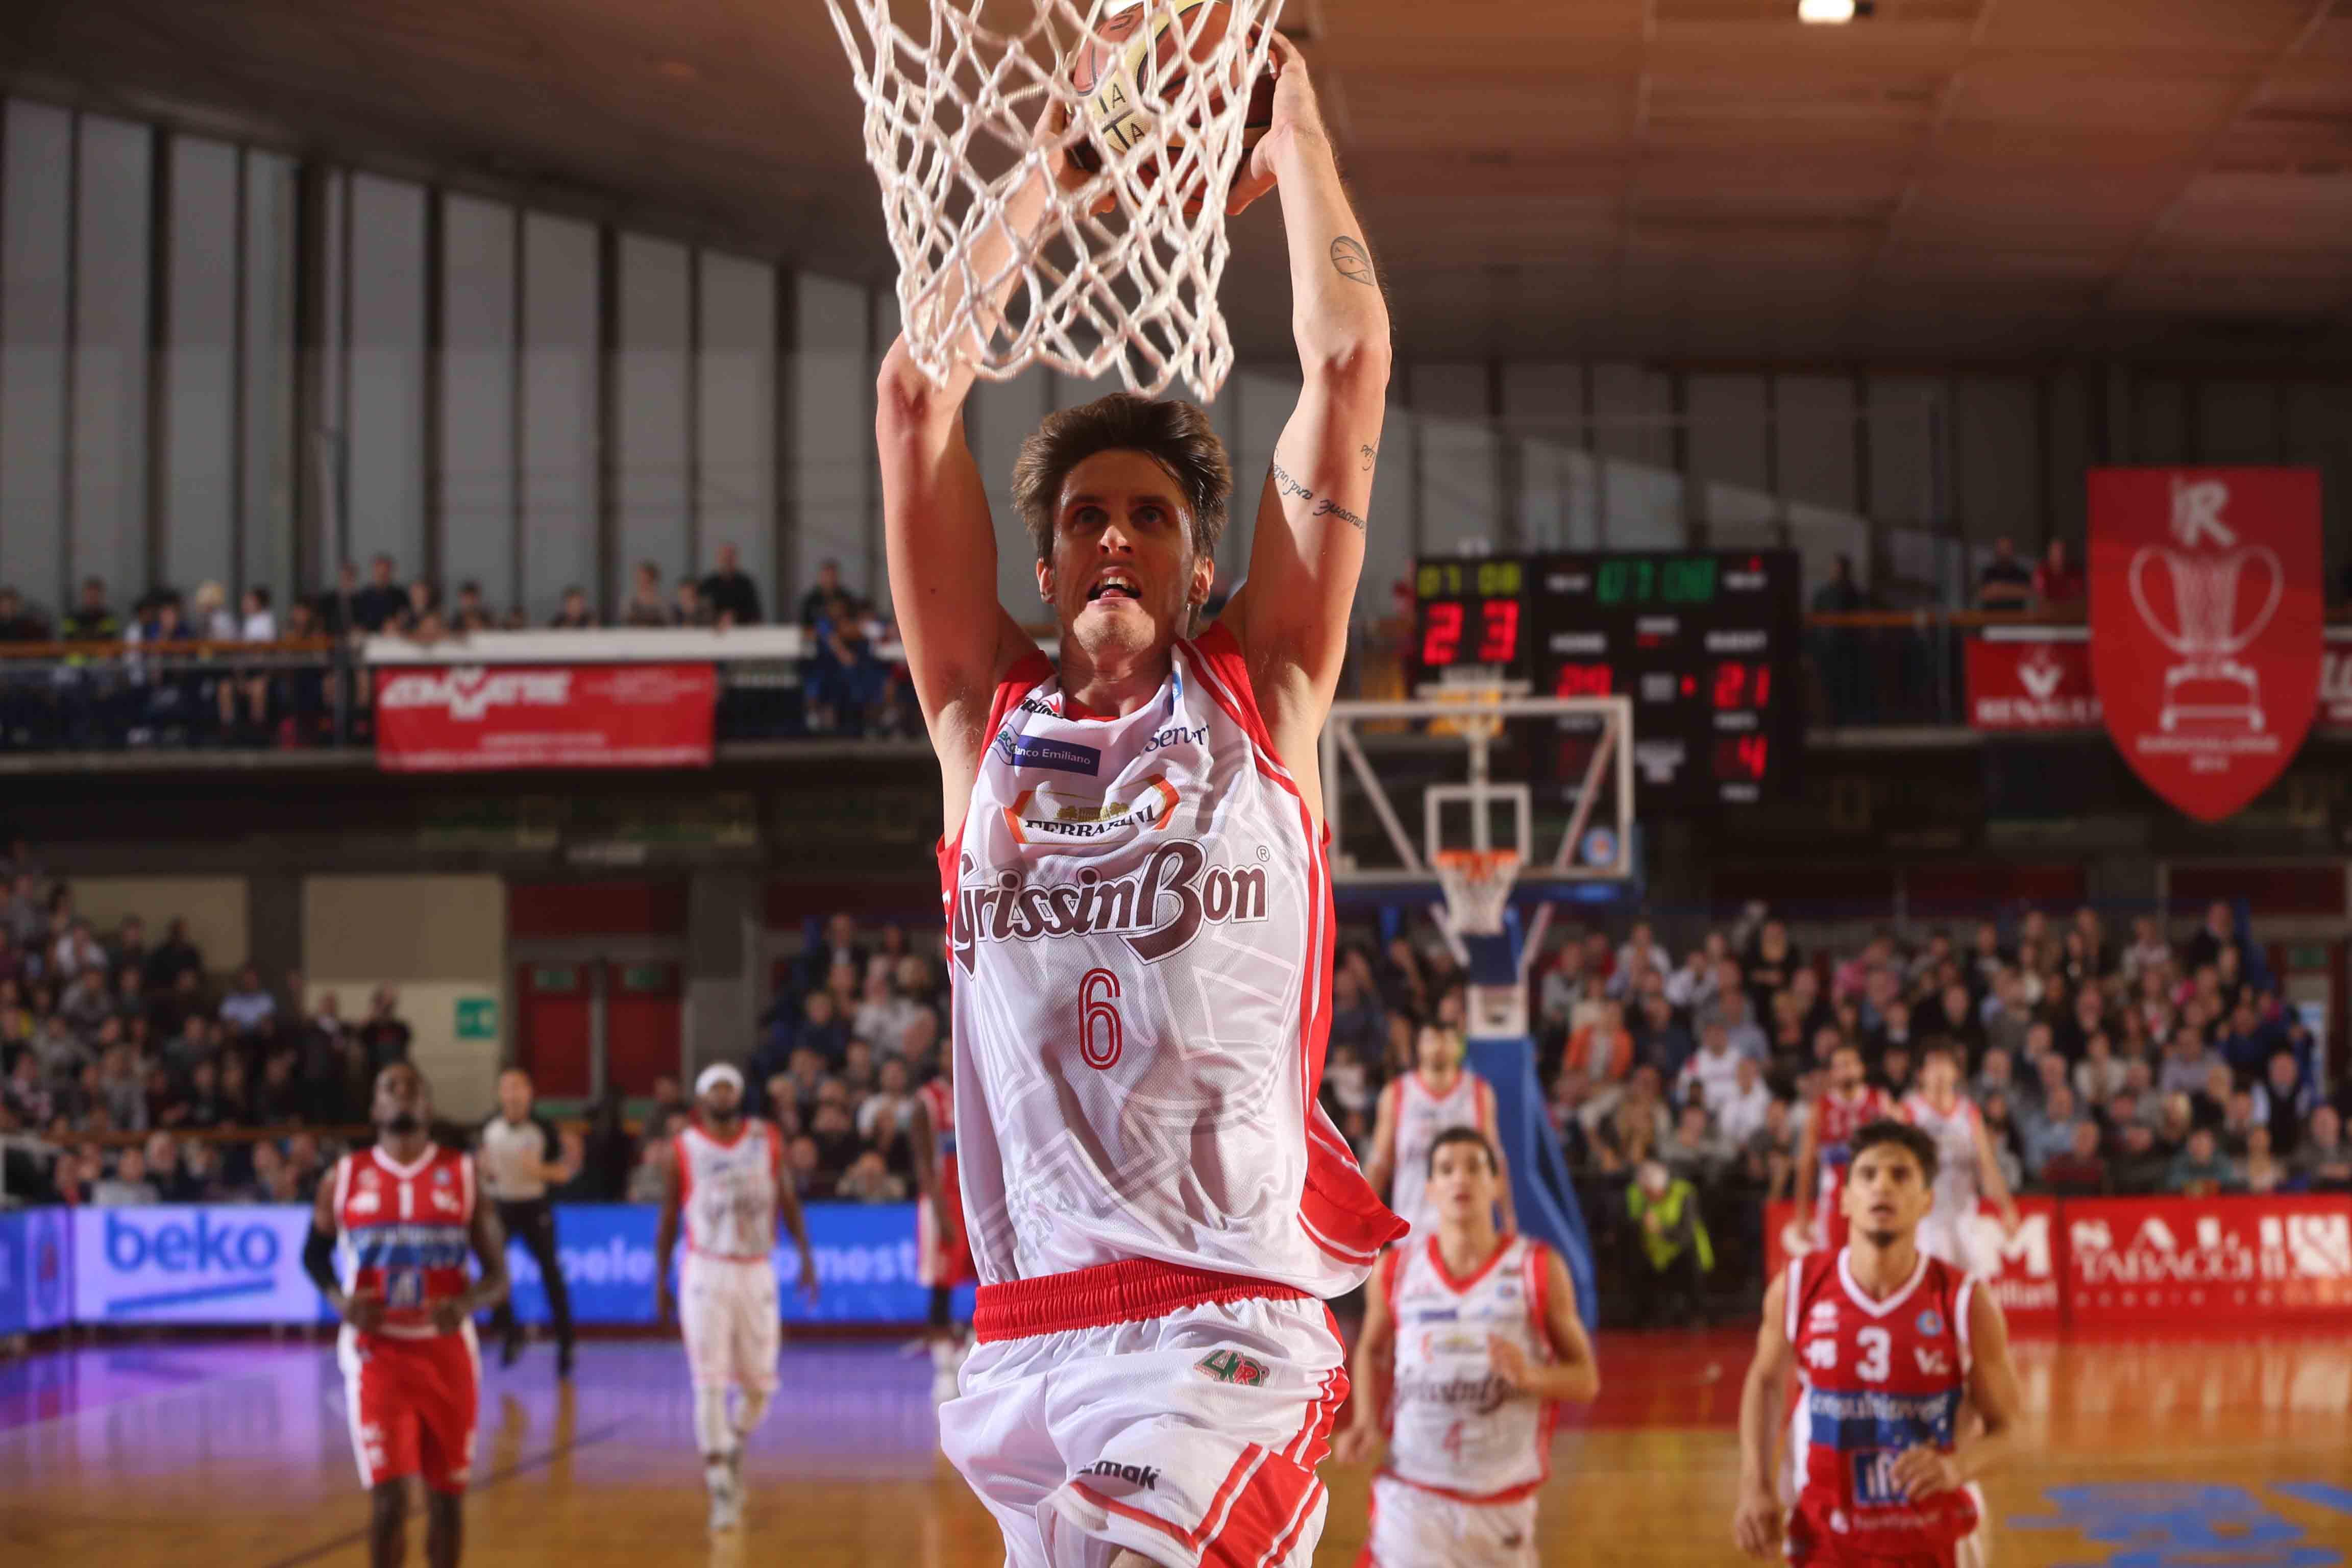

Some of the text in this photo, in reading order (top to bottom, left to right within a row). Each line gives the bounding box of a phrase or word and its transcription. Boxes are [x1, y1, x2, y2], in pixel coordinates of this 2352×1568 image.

[1042, 748, 1091, 765] Emiliano
[1077, 968, 1122, 1070] 6
[106, 1212, 278, 1272] beko
[1855, 1326, 1892, 1383] 3
